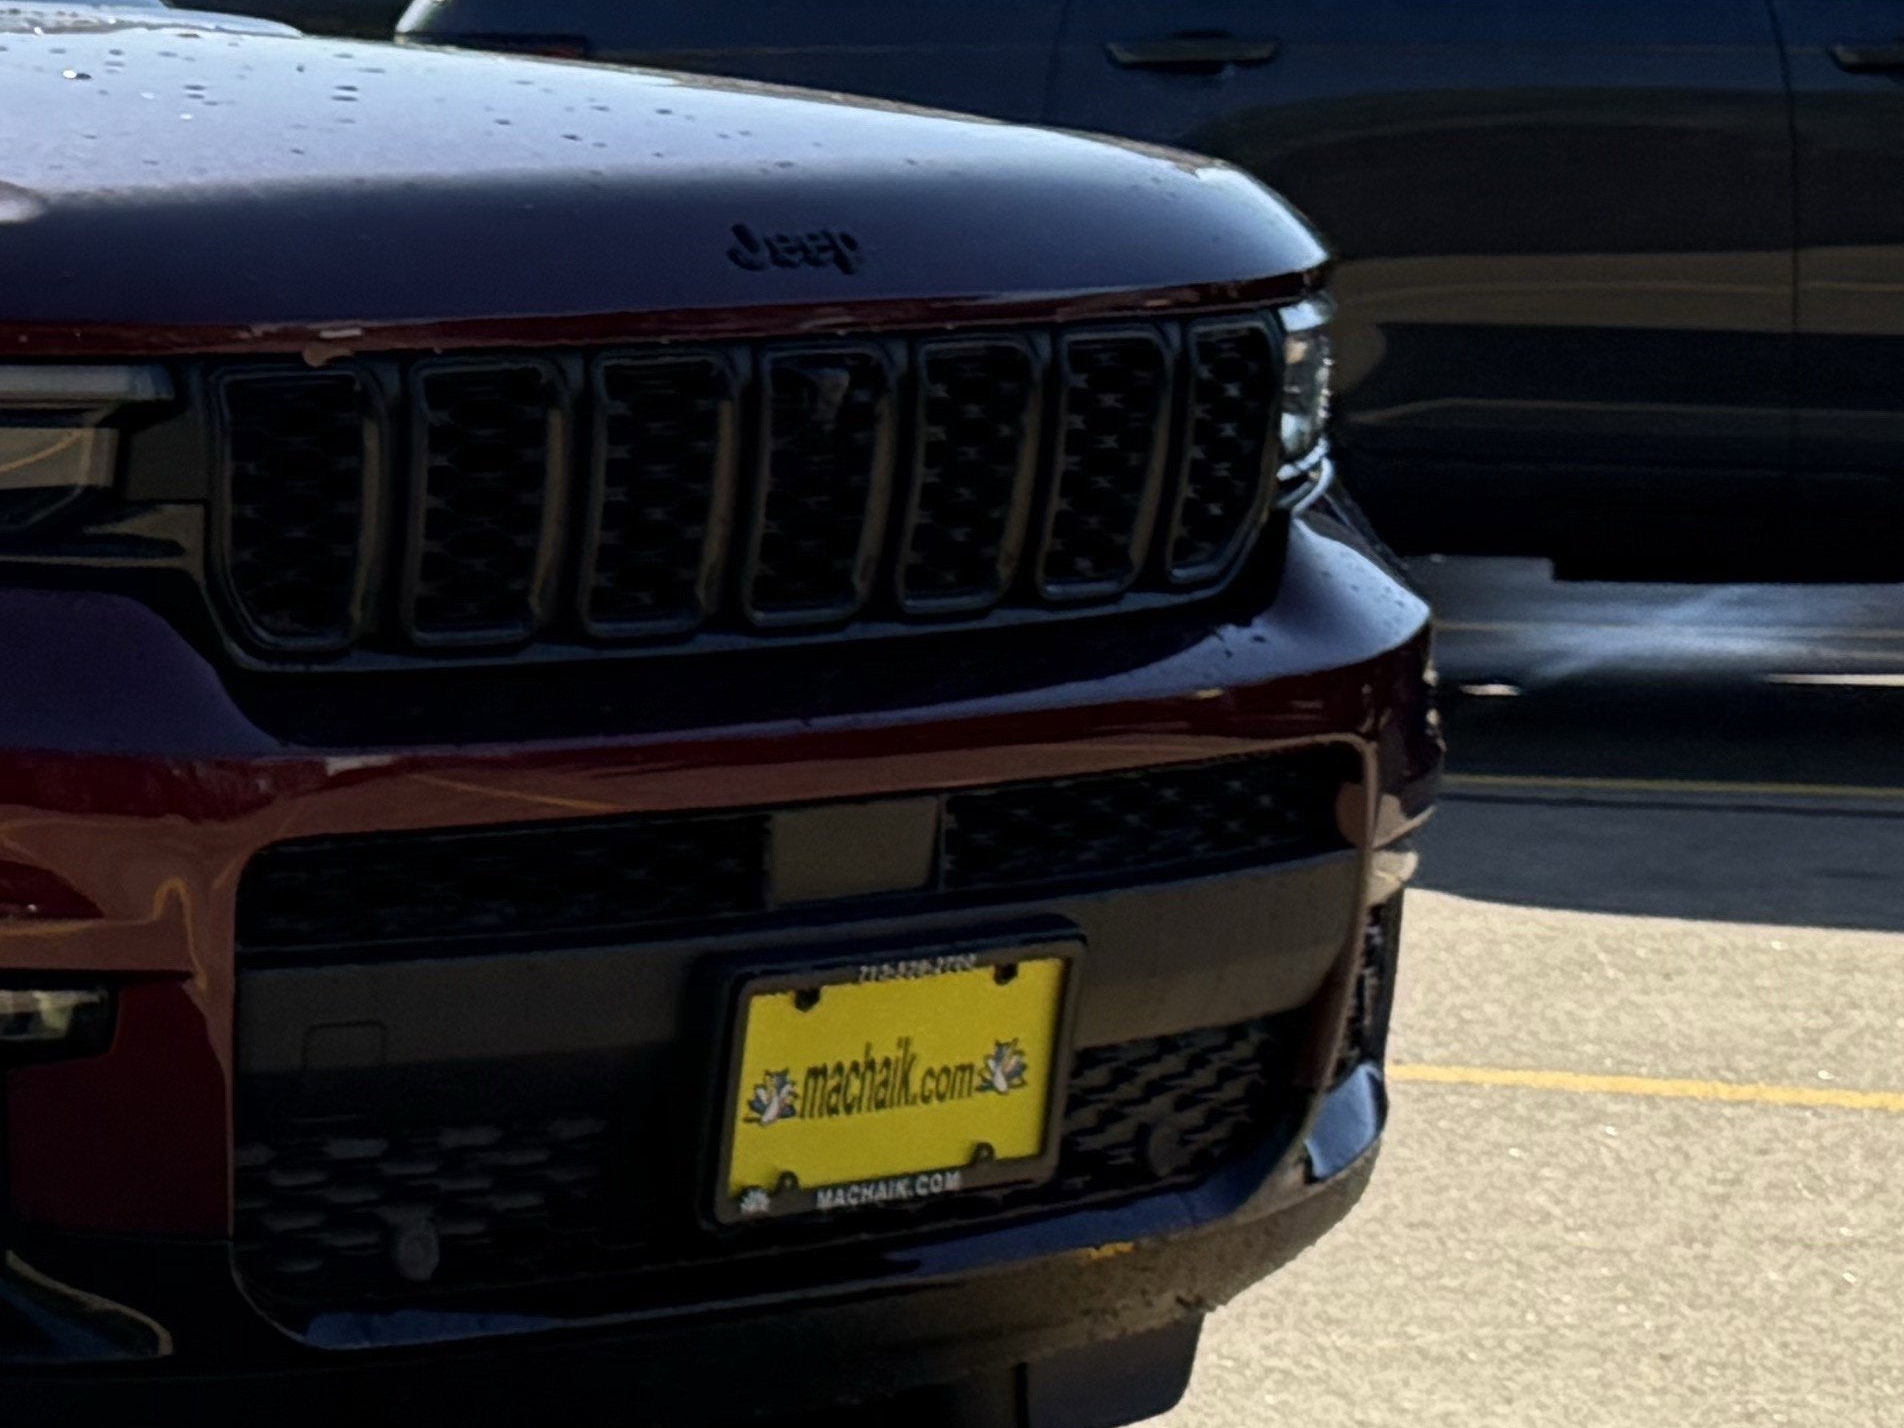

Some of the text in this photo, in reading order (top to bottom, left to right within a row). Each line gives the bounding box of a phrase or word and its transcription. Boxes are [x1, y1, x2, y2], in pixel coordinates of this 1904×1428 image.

[726, 223, 859, 275] Jeep
[798, 1036, 976, 1120] machaik.com
[815, 1170, 962, 1210] MACHAIK.COM
